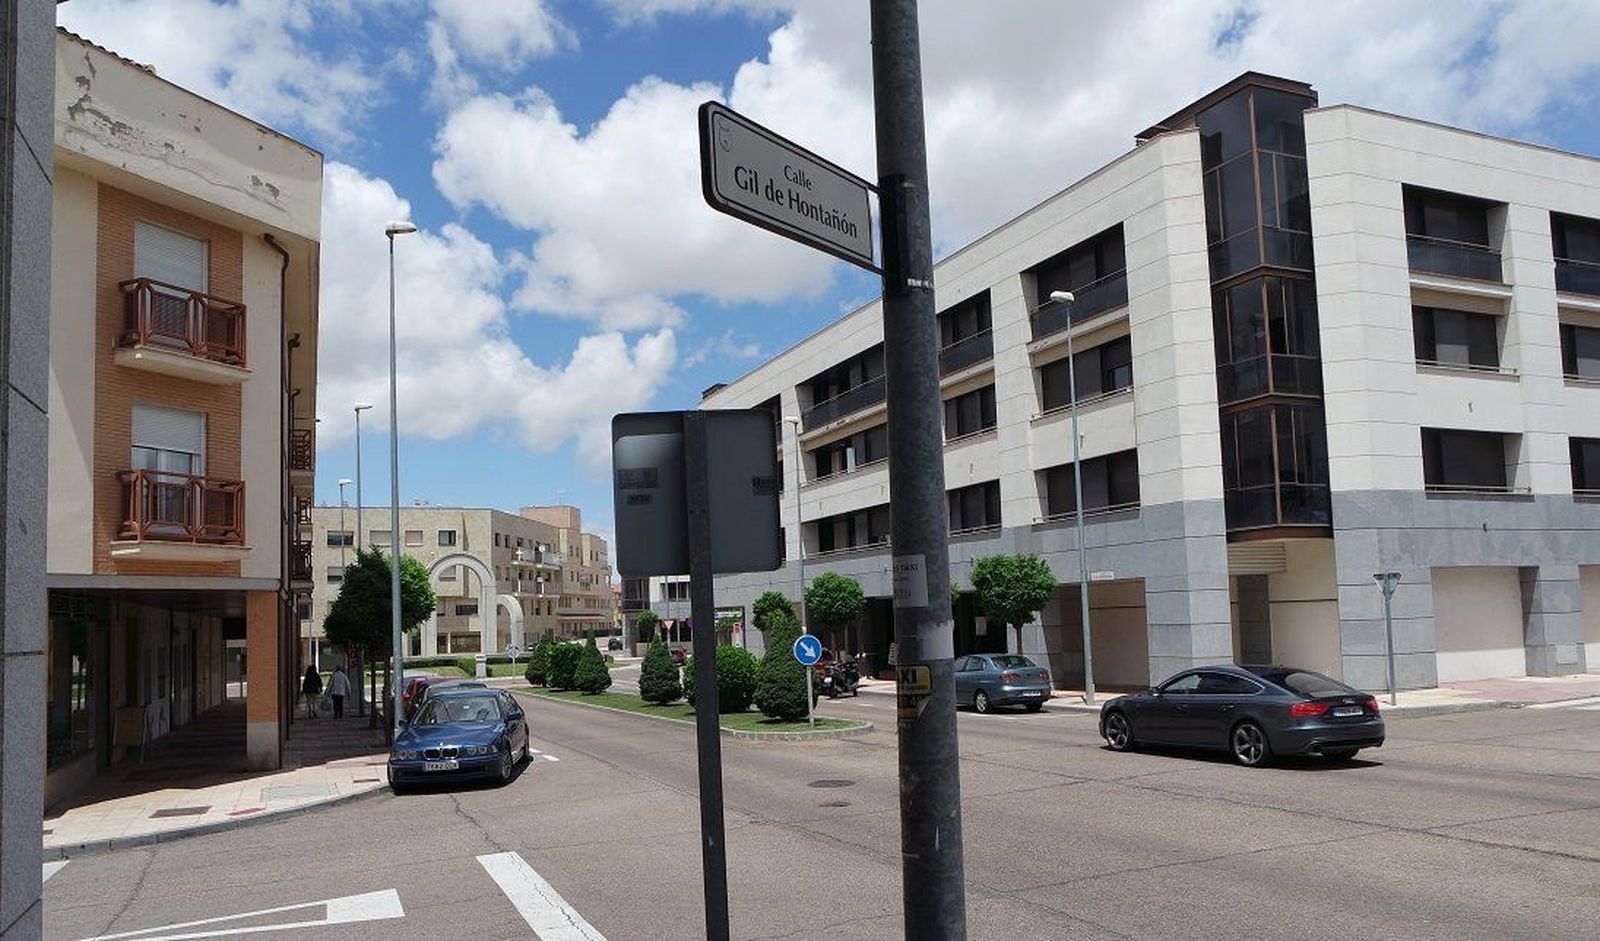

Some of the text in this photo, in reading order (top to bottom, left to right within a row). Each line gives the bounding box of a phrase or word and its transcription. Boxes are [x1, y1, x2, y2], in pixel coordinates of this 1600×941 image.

[734, 165, 858, 239] Gil de Hontañón
[784, 164, 812, 191] Calle
